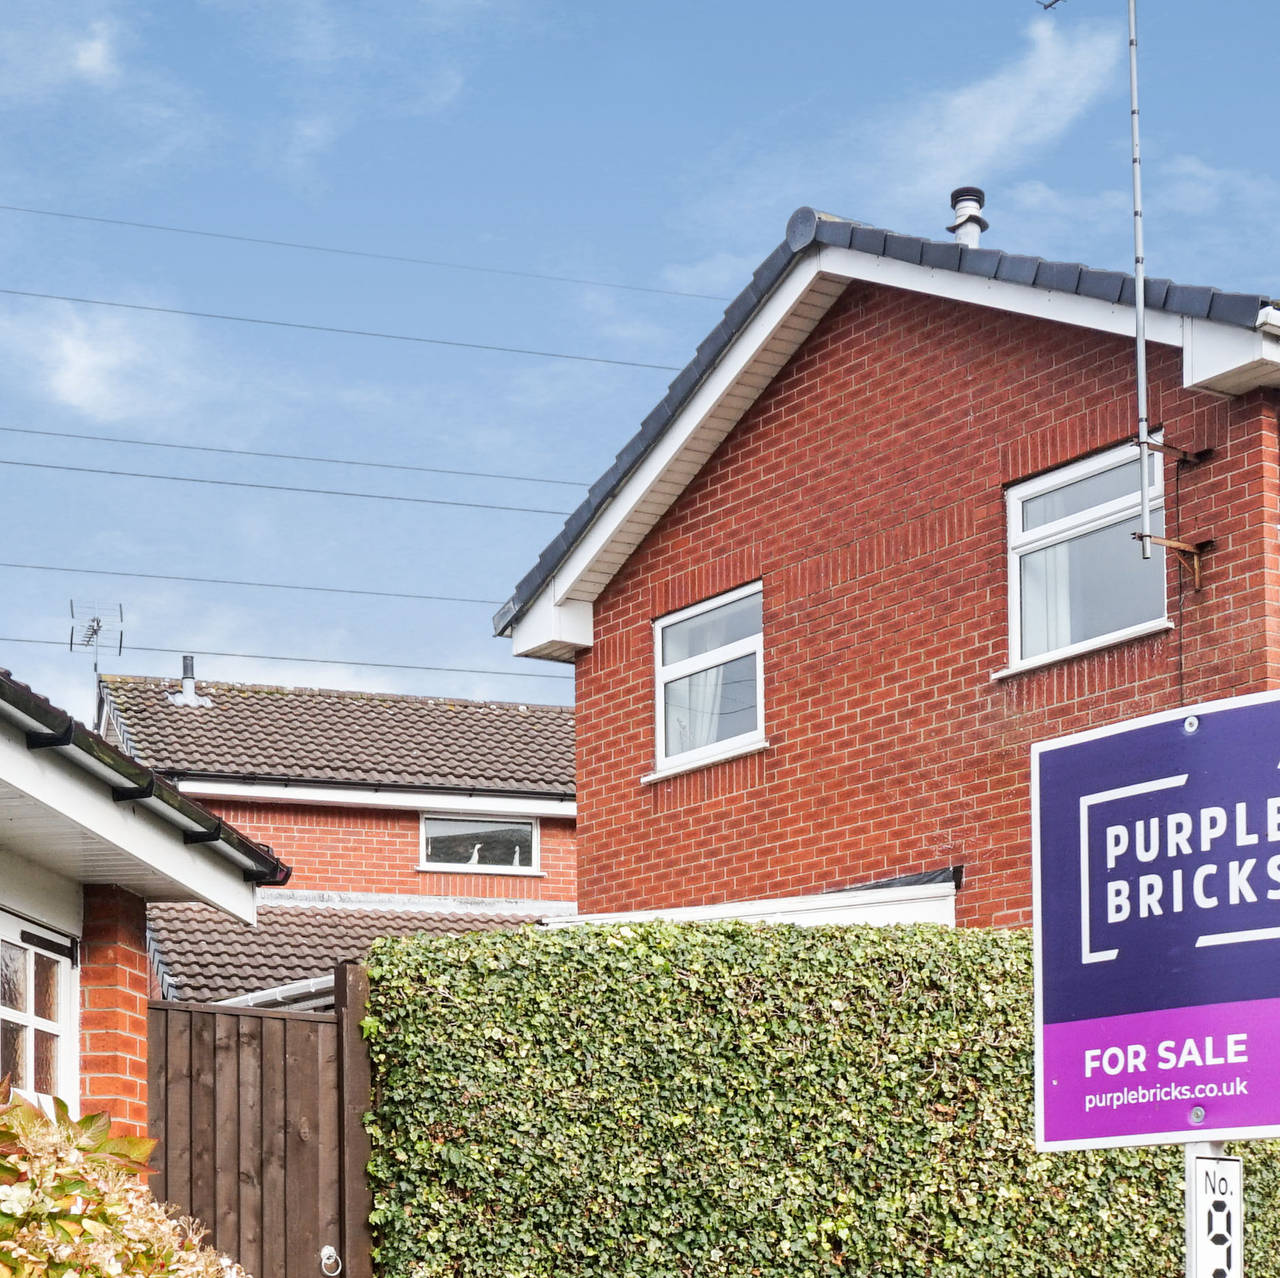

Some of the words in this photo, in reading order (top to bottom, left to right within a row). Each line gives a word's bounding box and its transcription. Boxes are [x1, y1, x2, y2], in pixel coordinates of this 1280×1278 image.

[1084, 1044, 1147, 1078] FOR
[1157, 1033, 1248, 1070] SALE
[1085, 1076, 1248, 1112] purplebricks.co.uk
[1204, 1170, 1233, 1196] No.
